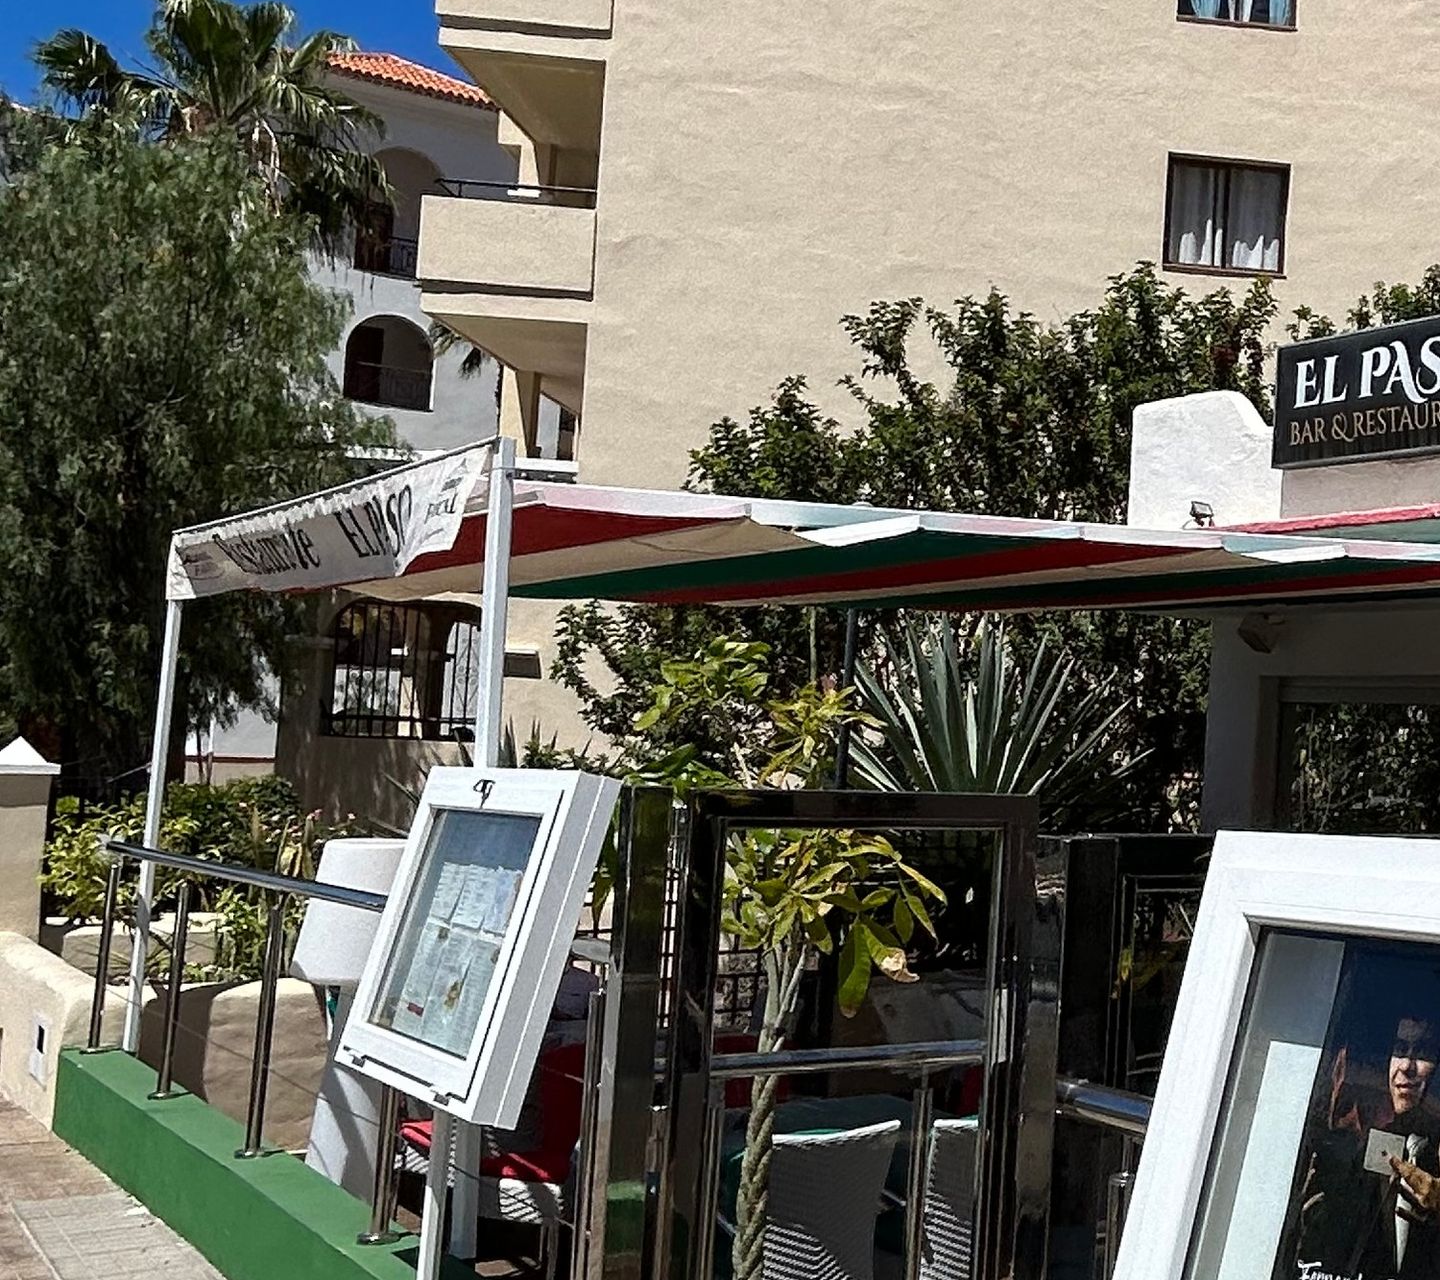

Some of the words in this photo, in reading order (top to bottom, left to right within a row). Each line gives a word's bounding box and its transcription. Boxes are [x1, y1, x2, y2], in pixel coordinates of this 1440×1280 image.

[1293, 354, 1348, 409] EL
[1289, 418, 1328, 446] BAR
[1330, 411, 1354, 443] &
